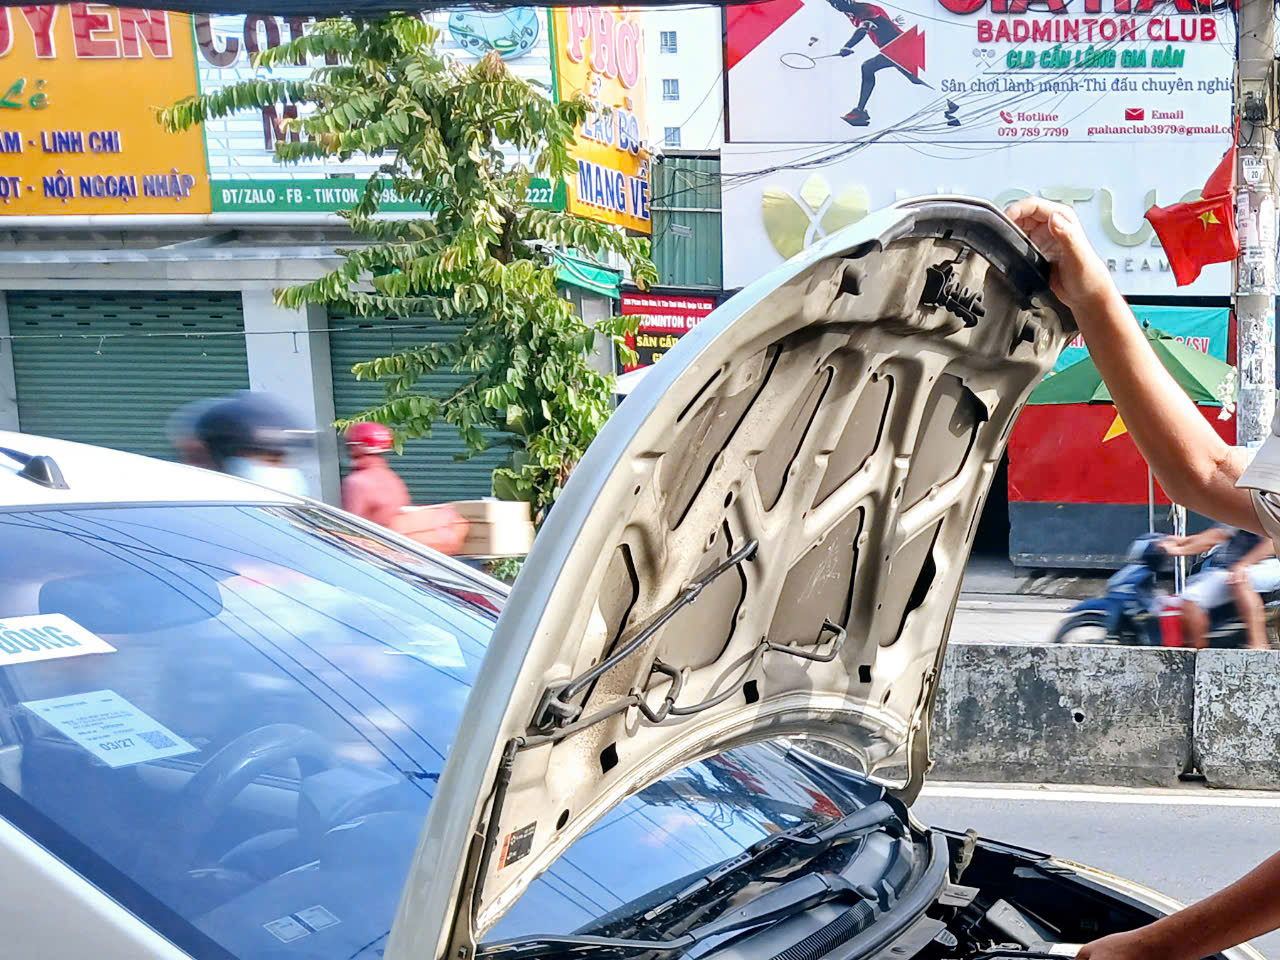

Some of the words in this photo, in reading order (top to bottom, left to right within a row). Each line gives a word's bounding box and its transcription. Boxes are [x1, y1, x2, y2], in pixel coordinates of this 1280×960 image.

[977, 18, 1136, 43] BADMINTON
[1147, 18, 1217, 42] CLUB
[1006, 48, 1035, 69] CLB
[1121, 48, 1147, 69] GIA
[941, 78, 967, 93] Sân
[970, 78, 1000, 93] chơi
[1002, 78, 1034, 93] lành
[1111, 77, 1139, 93] đấu
[1141, 78, 1197, 96] chuyên
[1017, 111, 1059, 123] Hotline
[1151, 110, 1184, 120] Email
[998, 127, 1019, 138] 079
[1020, 127, 1041, 138] 789
[1042, 126, 1070, 138] 7799
[1087, 124, 1232, 136] giahanclub3979@gmail.co
[41, 131, 86, 153] LINH
[89, 131, 123, 153] CHI
[43, 168, 76, 203] NỘI
[79, 175, 139, 203] NGOẠI
[142, 168, 196, 202] NHẬP
[578, 160, 627, 213] MANG
[222, 188, 276, 204] ĐT/ZALO
[286, 188, 303, 204] FB
[314, 188, 359, 204] TIKTOK
[1107, 258, 1171, 272] REAM
[640, 314, 685, 329] DMINTON
[100, 737, 135, 751] 03/27
